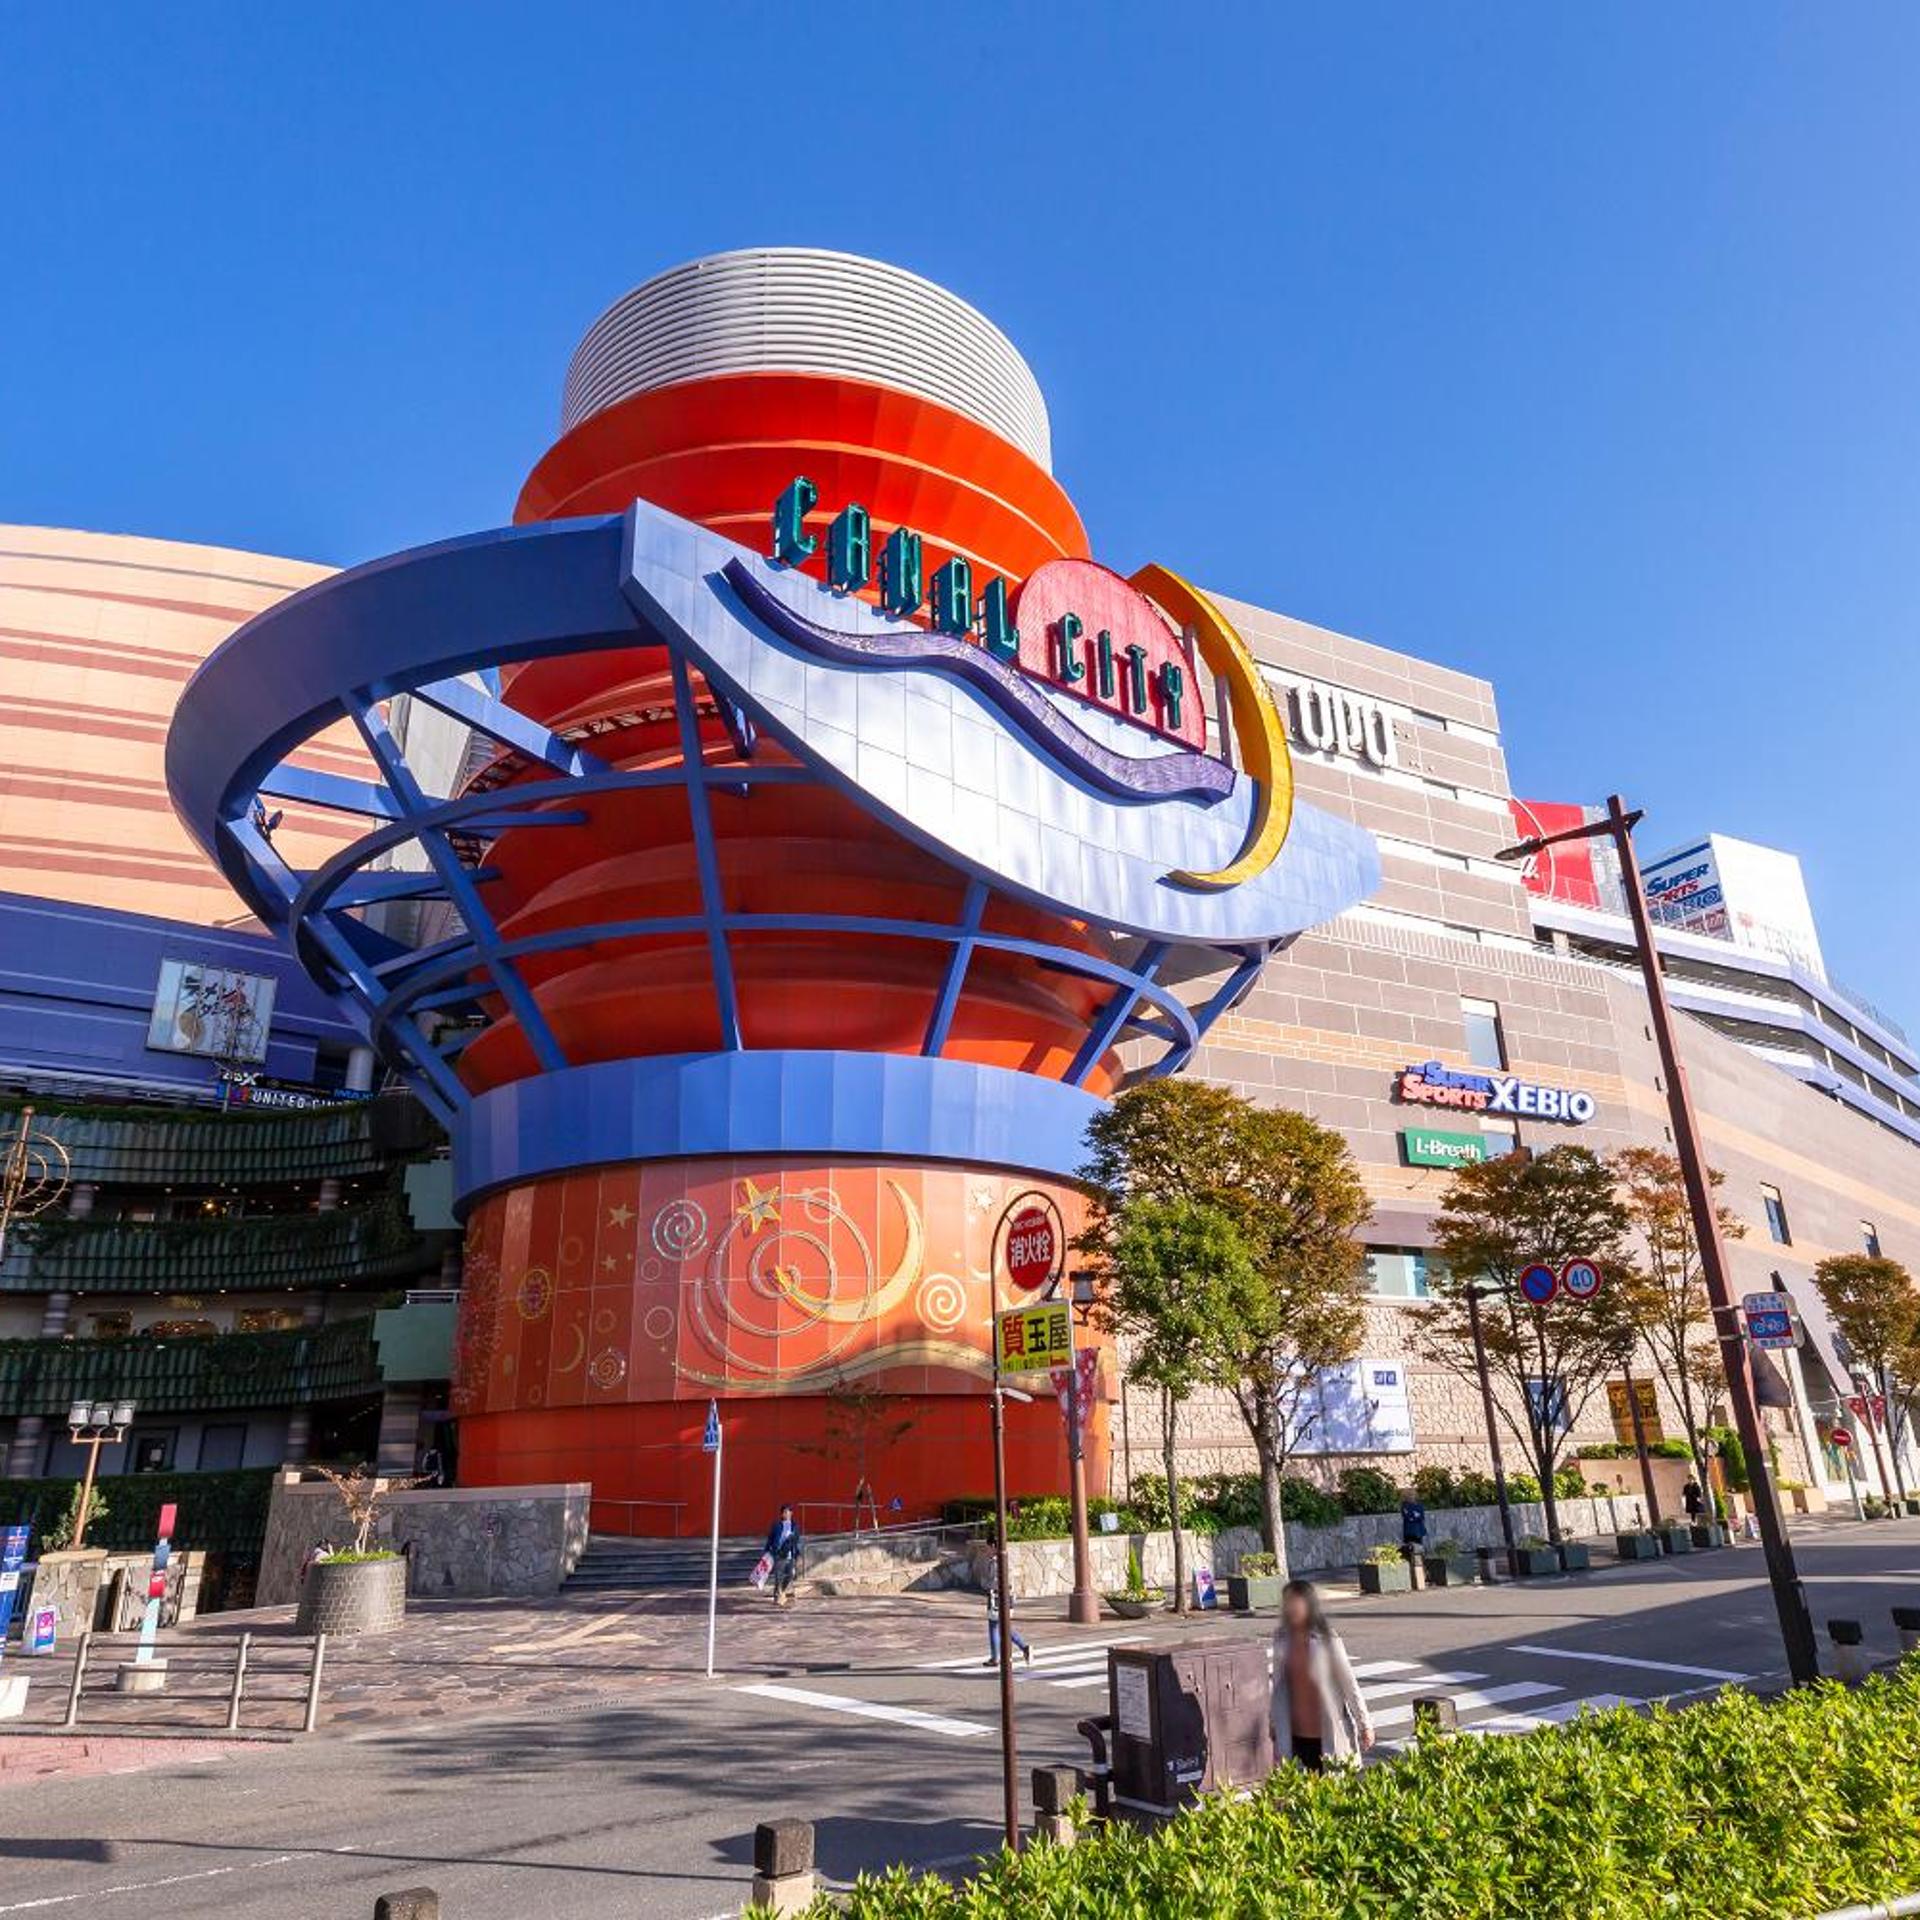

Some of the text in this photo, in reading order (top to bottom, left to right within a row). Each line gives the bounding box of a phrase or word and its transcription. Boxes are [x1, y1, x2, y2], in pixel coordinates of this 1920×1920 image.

[773, 476, 1019, 659] CANAL
[1059, 612, 1183, 731] CITY
[252, 1091, 305, 1109] UNITED
[1402, 1073, 1595, 1121] SPORTS XEBIO
[1010, 1229, 1051, 1268] 消火栓
[1572, 1268, 1593, 1288] 40
